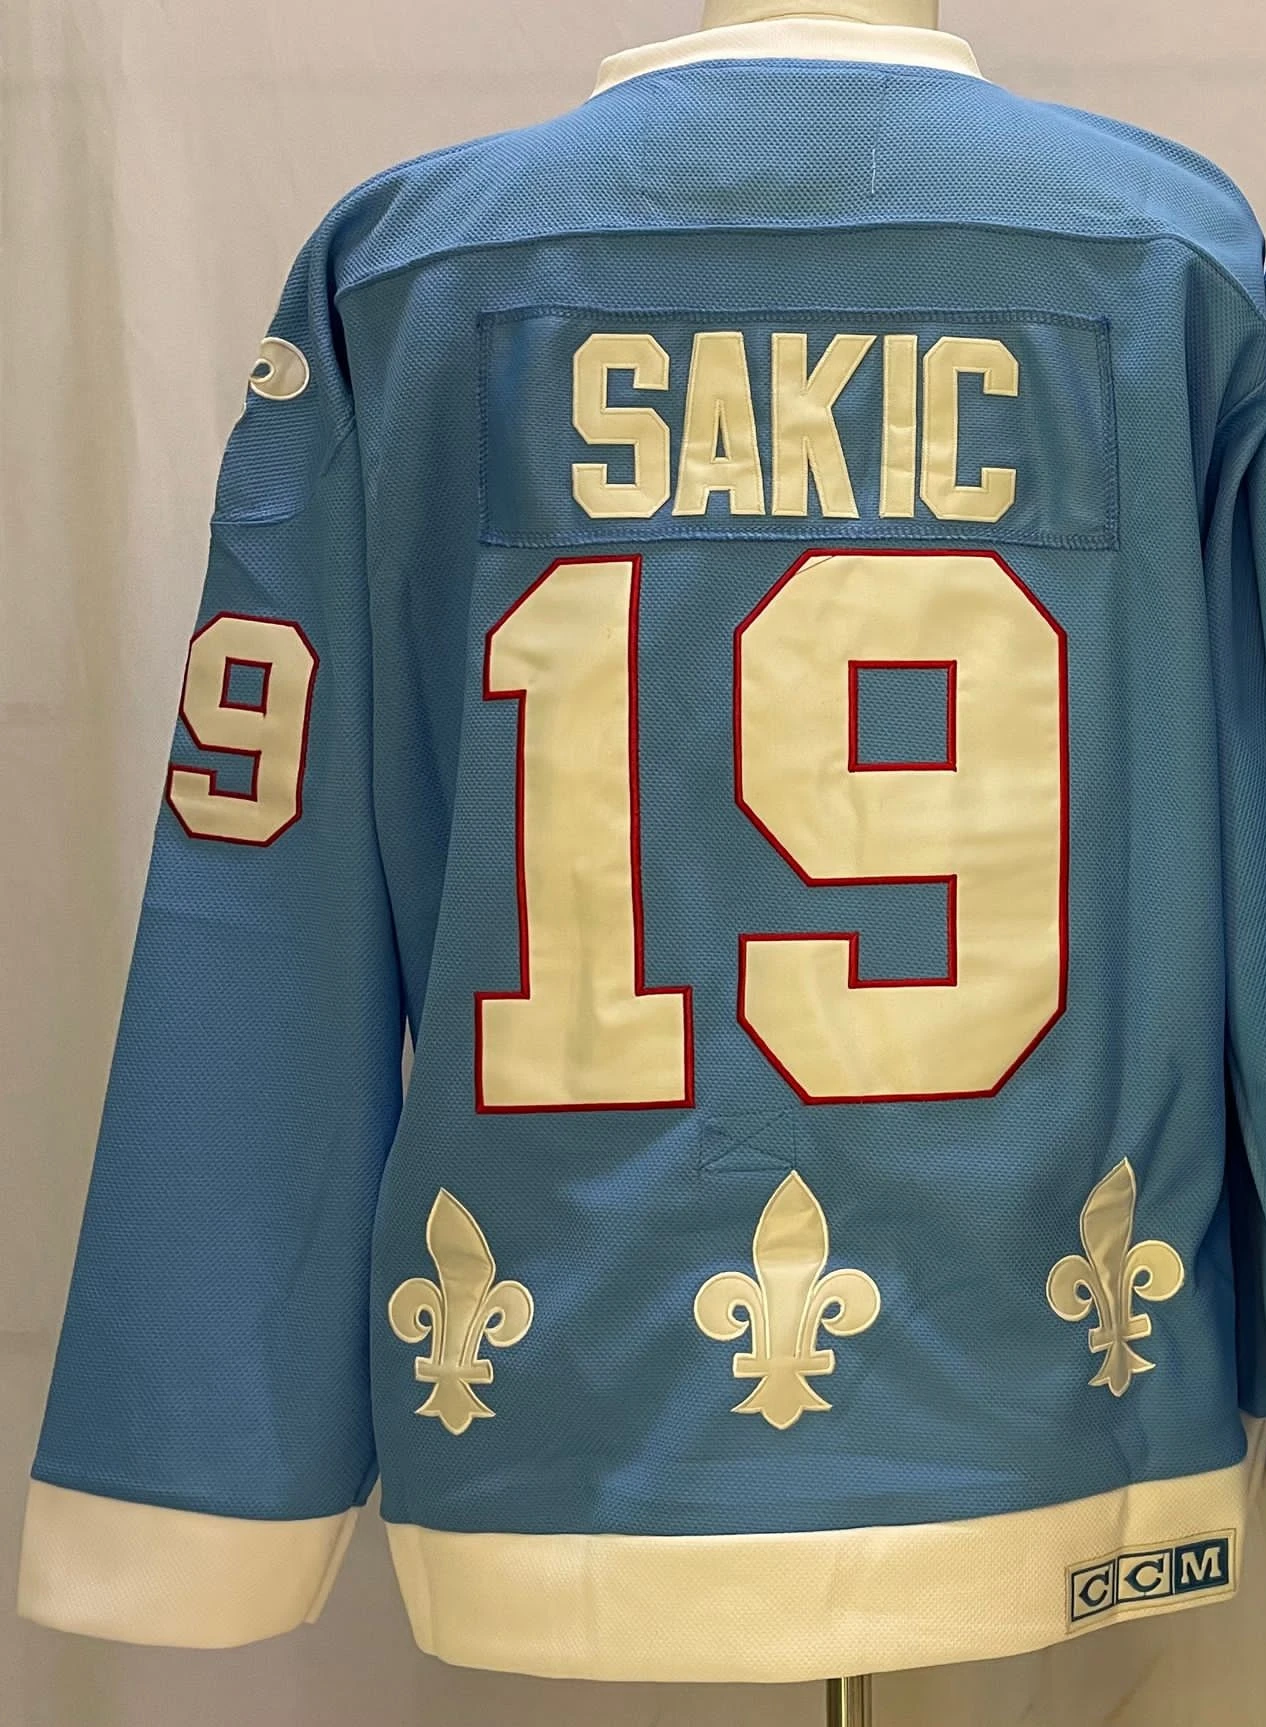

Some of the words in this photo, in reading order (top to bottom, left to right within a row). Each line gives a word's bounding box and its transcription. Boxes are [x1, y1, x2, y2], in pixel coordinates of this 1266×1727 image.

[571, 331, 1020, 523] SAKIC
[166, 611, 320, 847] 9
[474, 548, 1068, 1114] 19
[1077, 1546, 1222, 1607] CCM
